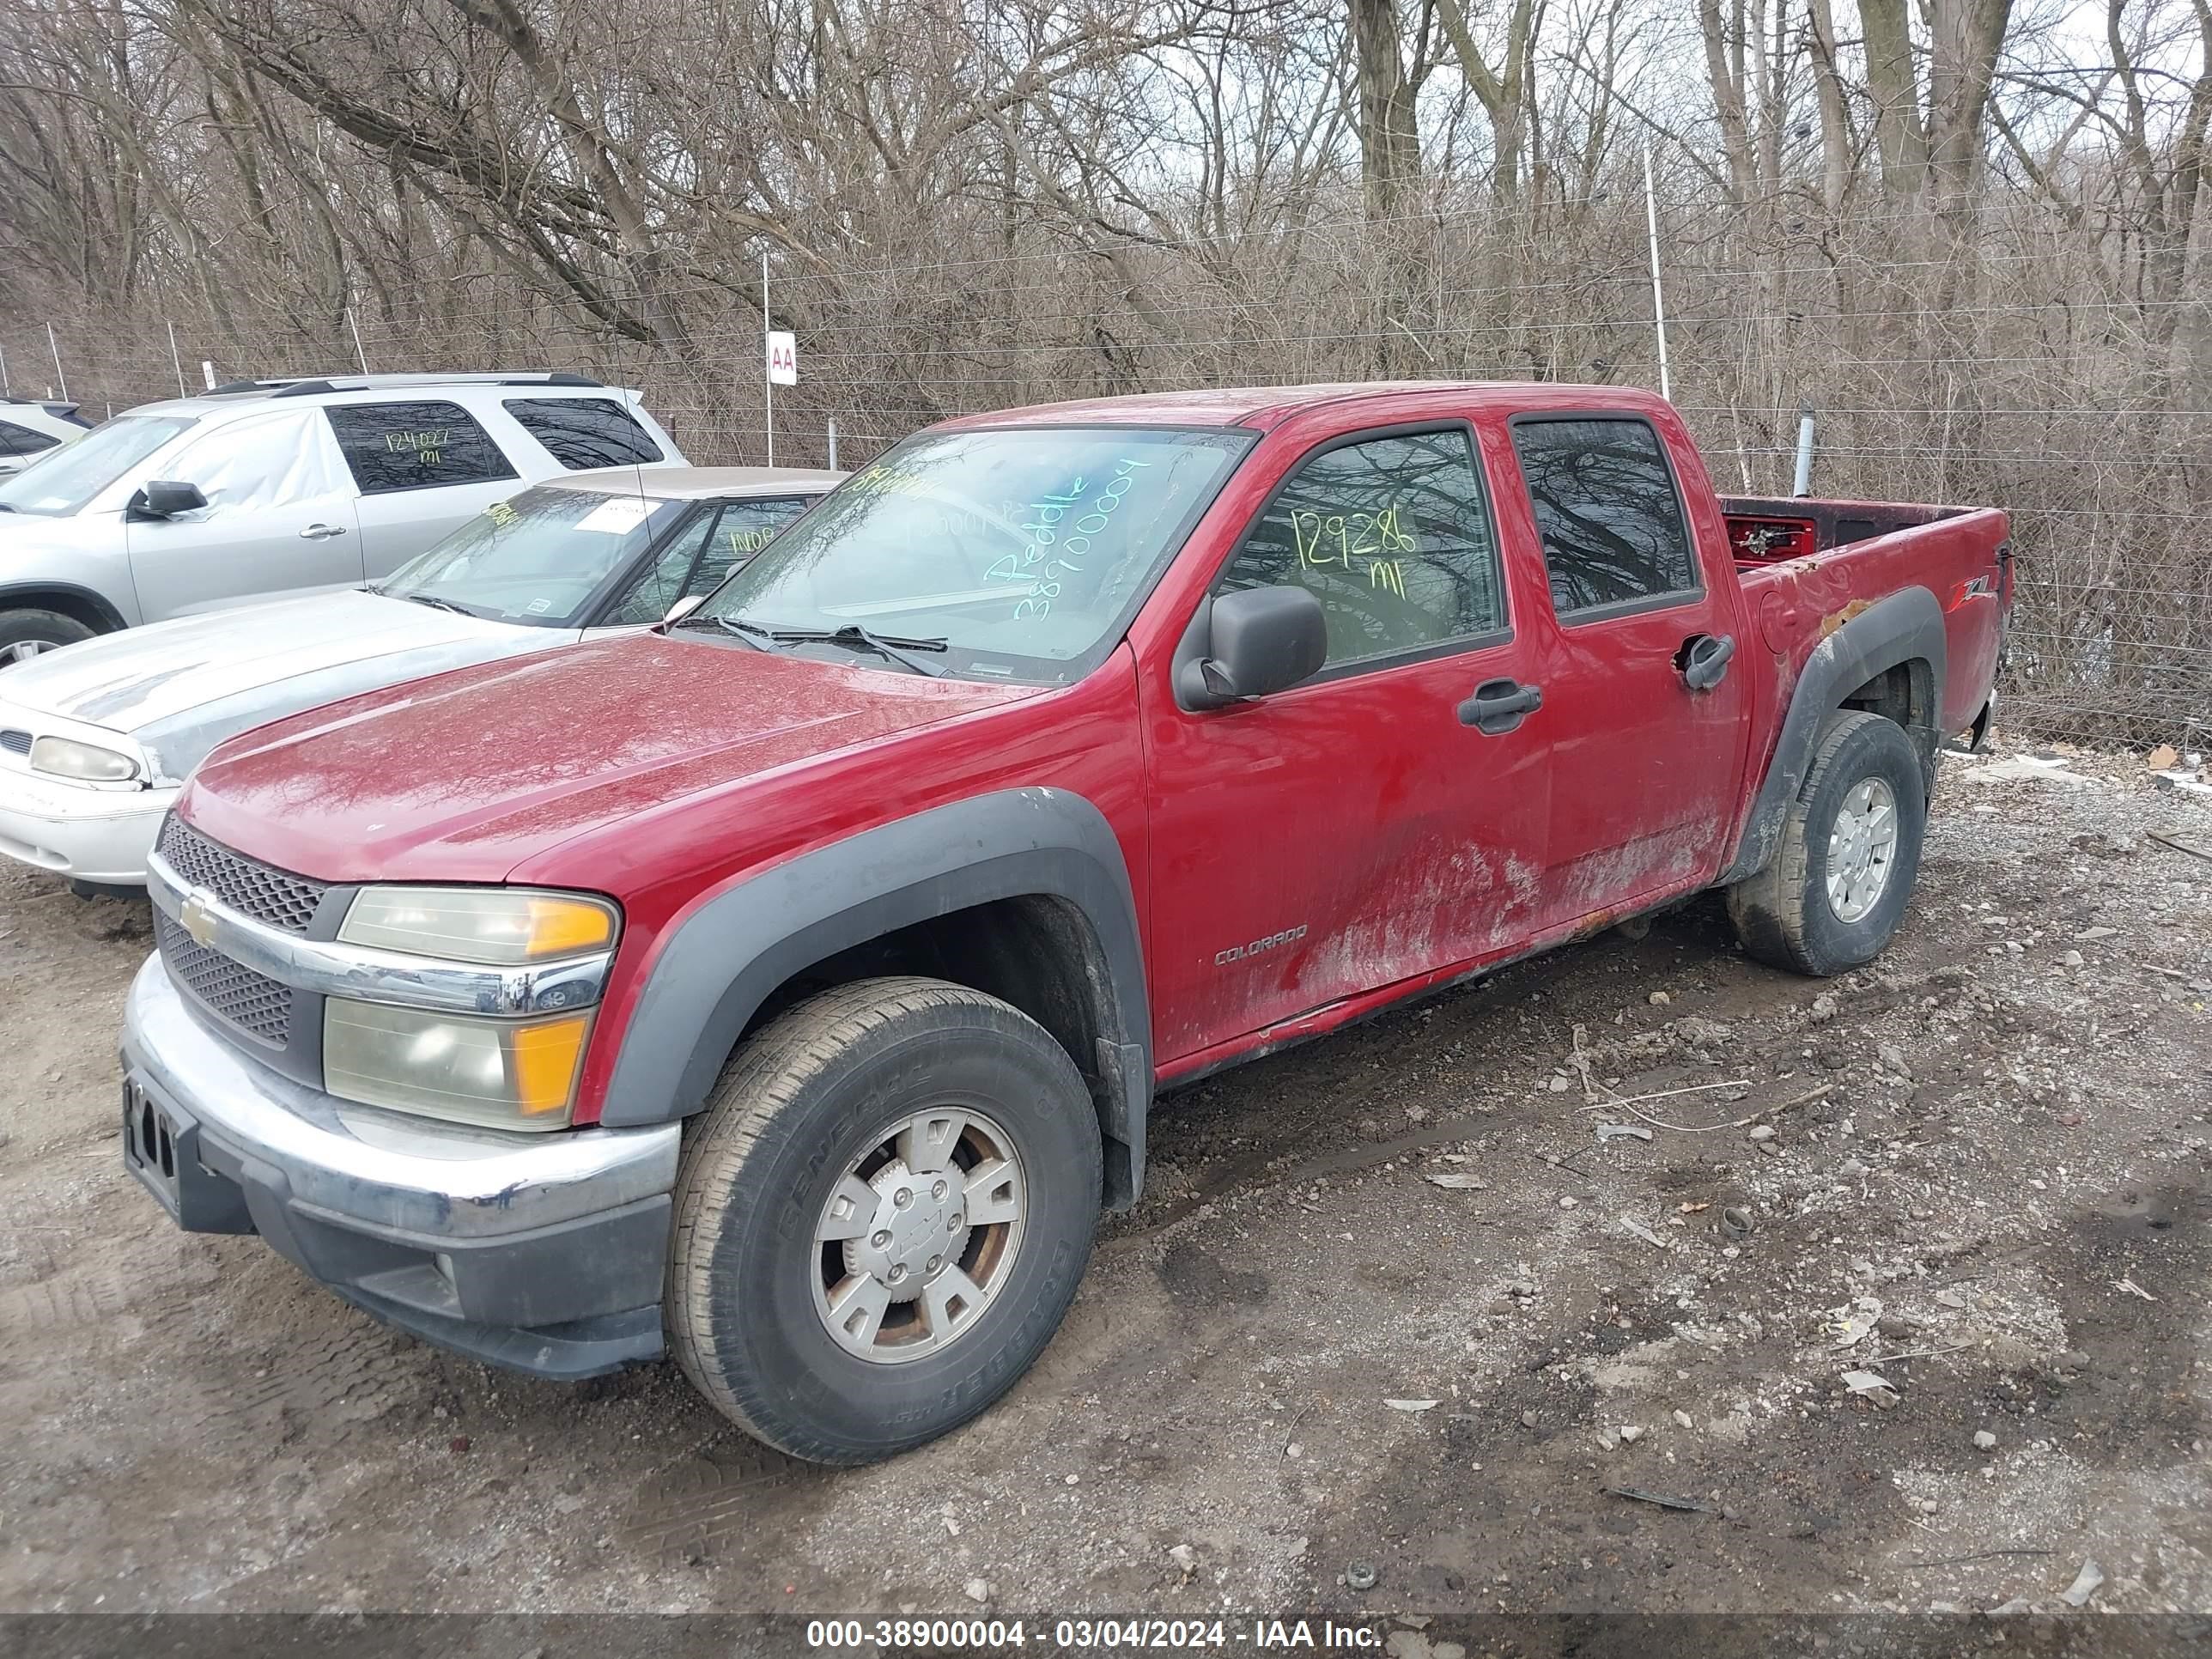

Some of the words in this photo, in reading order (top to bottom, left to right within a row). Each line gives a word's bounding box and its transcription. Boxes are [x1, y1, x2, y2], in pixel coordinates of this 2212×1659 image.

[772, 346, 794, 372] AA
[385, 428, 449, 453] 124027
[982, 476, 1091, 582] Peddle
[1290, 500, 1417, 571] 129286
[1213, 923, 1309, 968] COLORADO
[940, 1237, 1073, 1410] GRABBER
